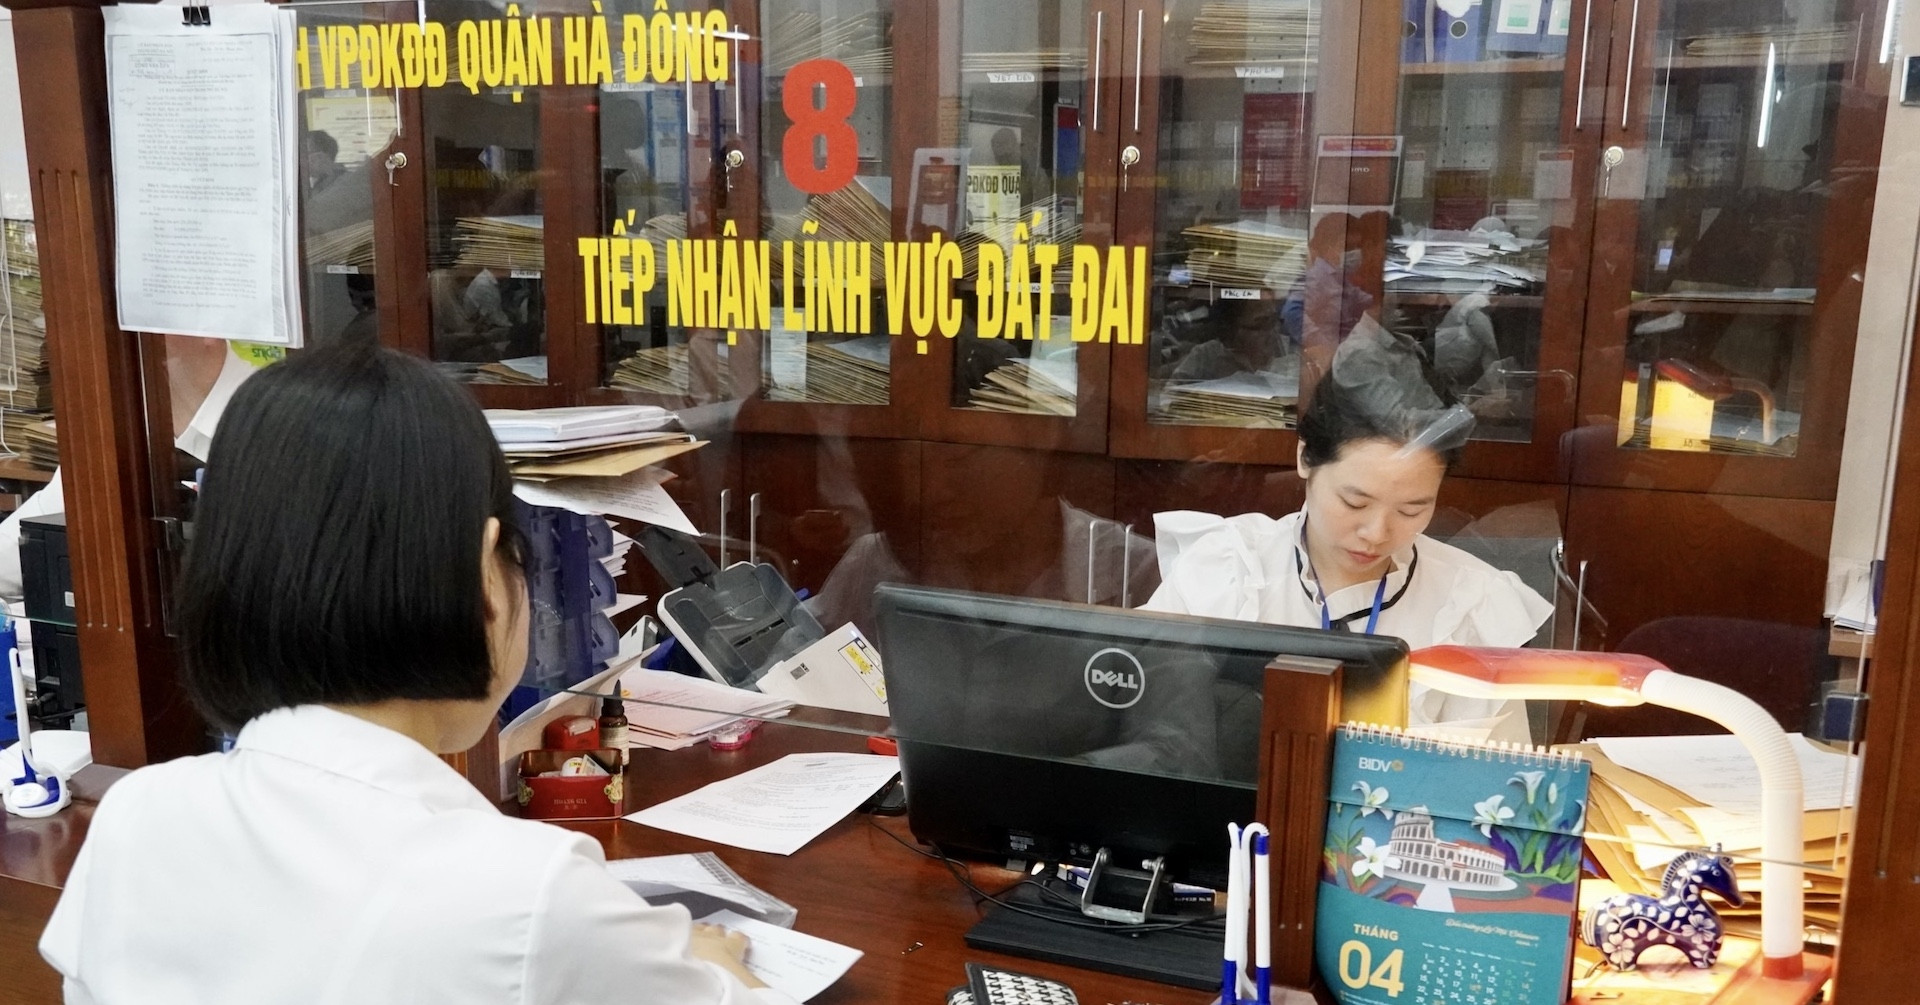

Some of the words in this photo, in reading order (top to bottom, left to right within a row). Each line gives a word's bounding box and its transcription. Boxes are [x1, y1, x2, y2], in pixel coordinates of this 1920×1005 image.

[317, 22, 448, 90] VPĐKĐĐ
[458, 3, 552, 103] QUẬN
[564, 0, 614, 84] HÀ
[622, 0, 729, 84] ĐÔNG
[783, 60, 859, 195] 8
[578, 208, 657, 326] TIẾP
[666, 218, 772, 346] NHẬN
[783, 226, 874, 334] LĨNH
[883, 231, 964, 355] VỰC
[976, 210, 1060, 342] ĐẤT
[1070, 244, 1147, 345] ĐAI
[1091, 668, 1139, 690] DELL
[1358, 756, 1392, 773] BIDV
[1353, 922, 1400, 942] THÁNG
[1338, 939, 1405, 998] 04
